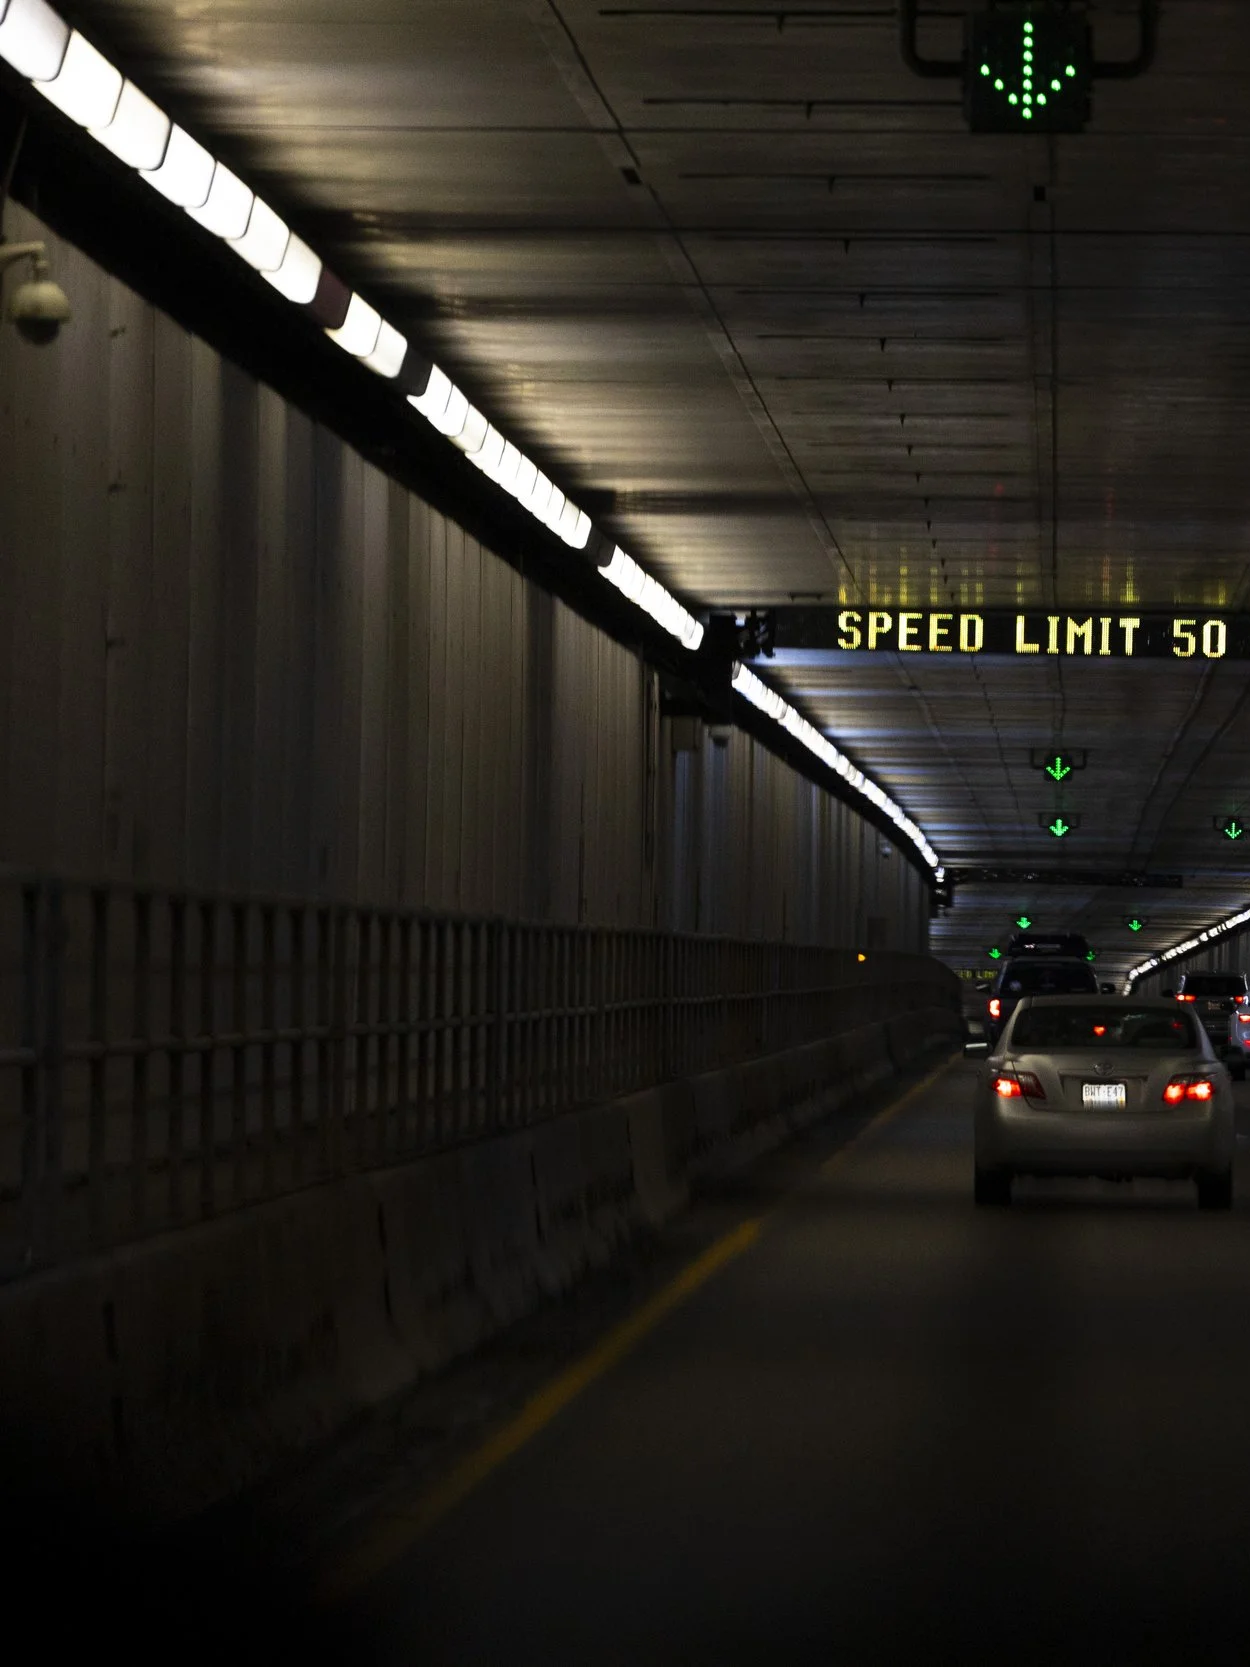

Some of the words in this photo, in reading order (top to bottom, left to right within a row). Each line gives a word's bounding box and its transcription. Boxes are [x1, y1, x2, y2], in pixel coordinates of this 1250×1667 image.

[837, 610, 984, 652] SPEED
[1015, 614, 1141, 656] LIMIT
[1172, 618, 1227, 658] 50
